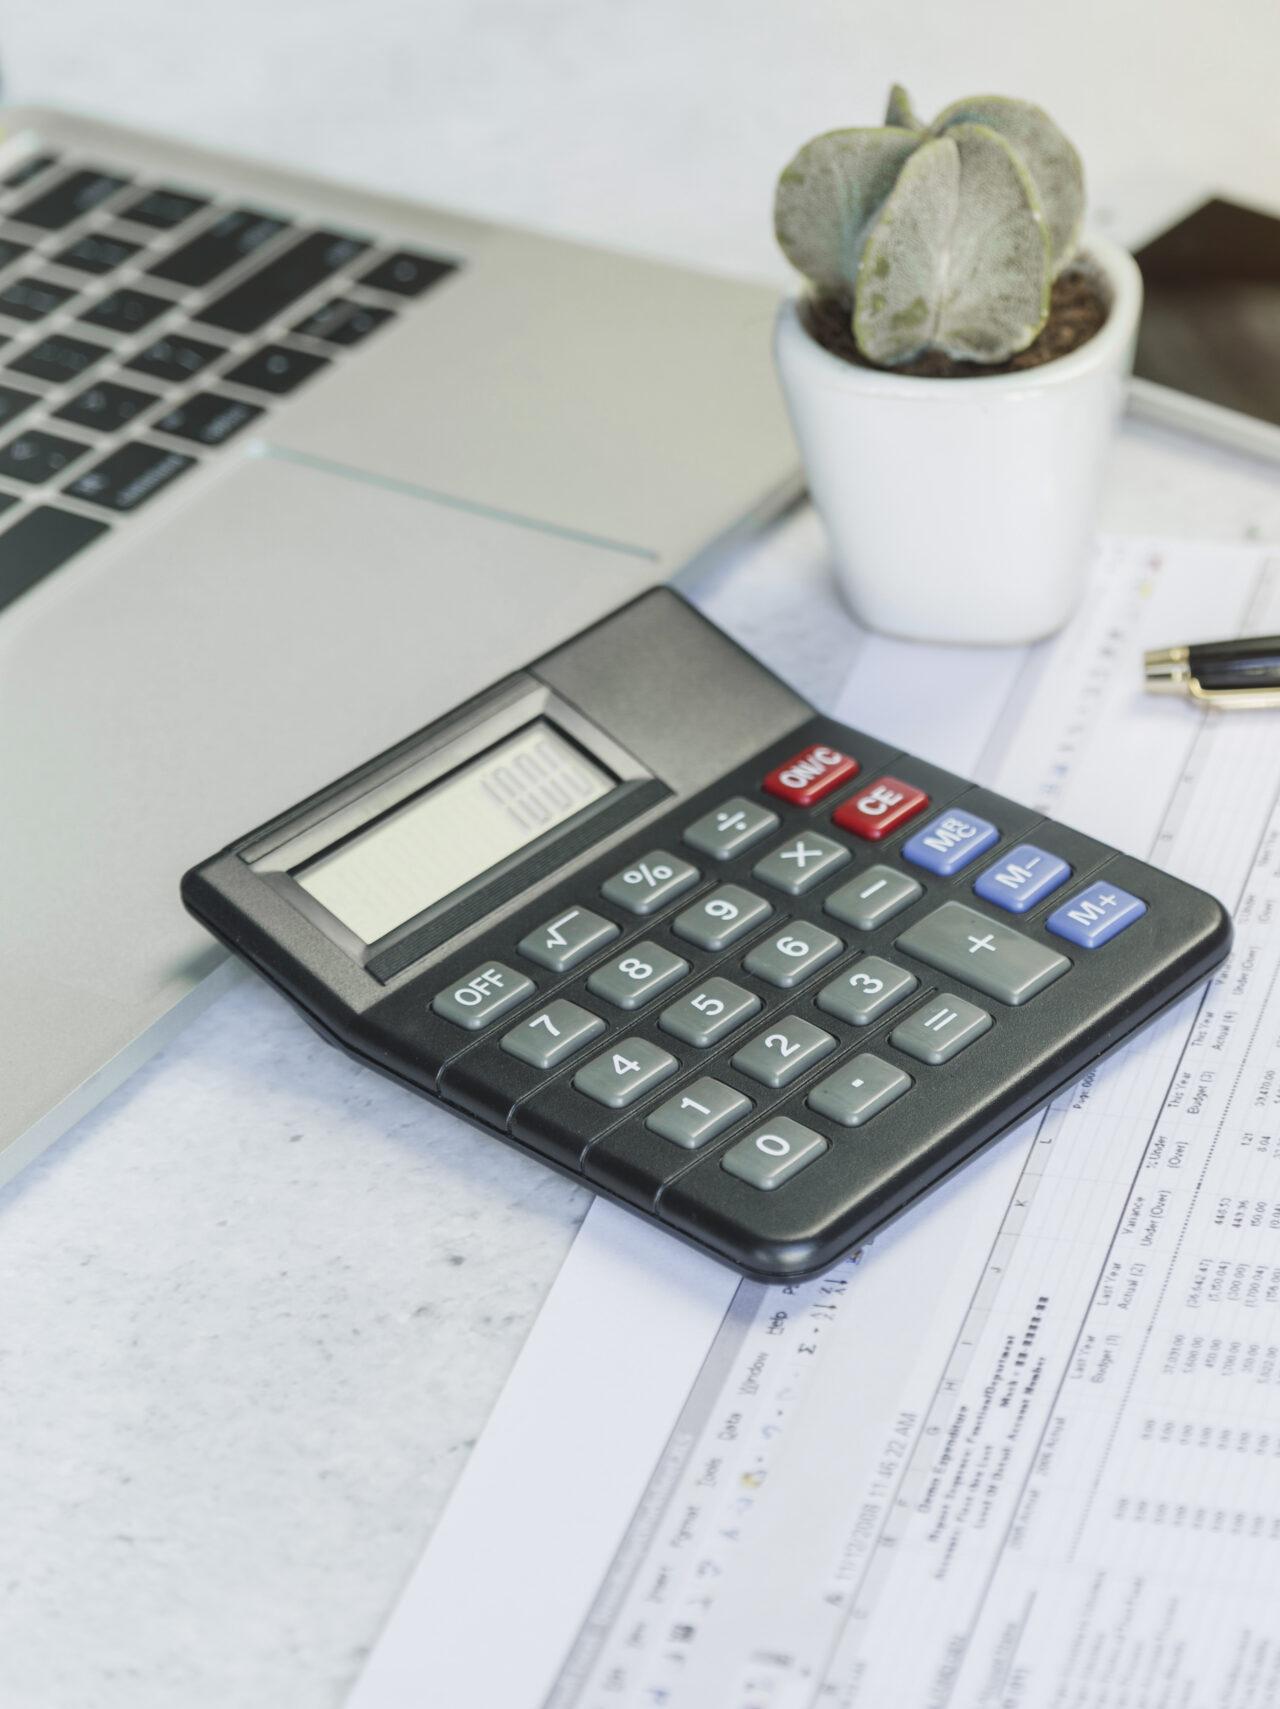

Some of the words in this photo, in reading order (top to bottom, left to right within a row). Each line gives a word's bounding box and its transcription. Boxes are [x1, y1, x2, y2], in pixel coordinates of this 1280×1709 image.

[779, 745, 842, 789] ON/C
[857, 784, 904, 816] CE
[704, 899, 739, 920] 9
[1067, 891, 1117, 926] M+
[775, 936, 810, 958] 6
[617, 958, 653, 980] 8
[454, 968, 504, 1007] OFF
[849, 972, 884, 995] 3
[691, 994, 724, 1016] 5
[529, 1014, 560, 1037] 7
[764, 1034, 800, 1057] 2
[612, 1054, 641, 1076] 4
[1175, 1071, 1192, 1089] Year
[680, 1097, 711, 1116] 1
[1168, 1091, 1184, 1107] This
[1186, 1084, 1211, 1114] Budget
[755, 1134, 791, 1156] 0
[1149, 1135, 1168, 1160] Under
[1166, 1140, 1189, 1168] (Over)
[1121, 1196, 1146, 1234] Variance
[1148, 1189, 1172, 1218] (Over)
[1138, 1219, 1160, 1246] Under
[763, 1310, 791, 1335] Help
[735, 1350, 773, 1396] Window
